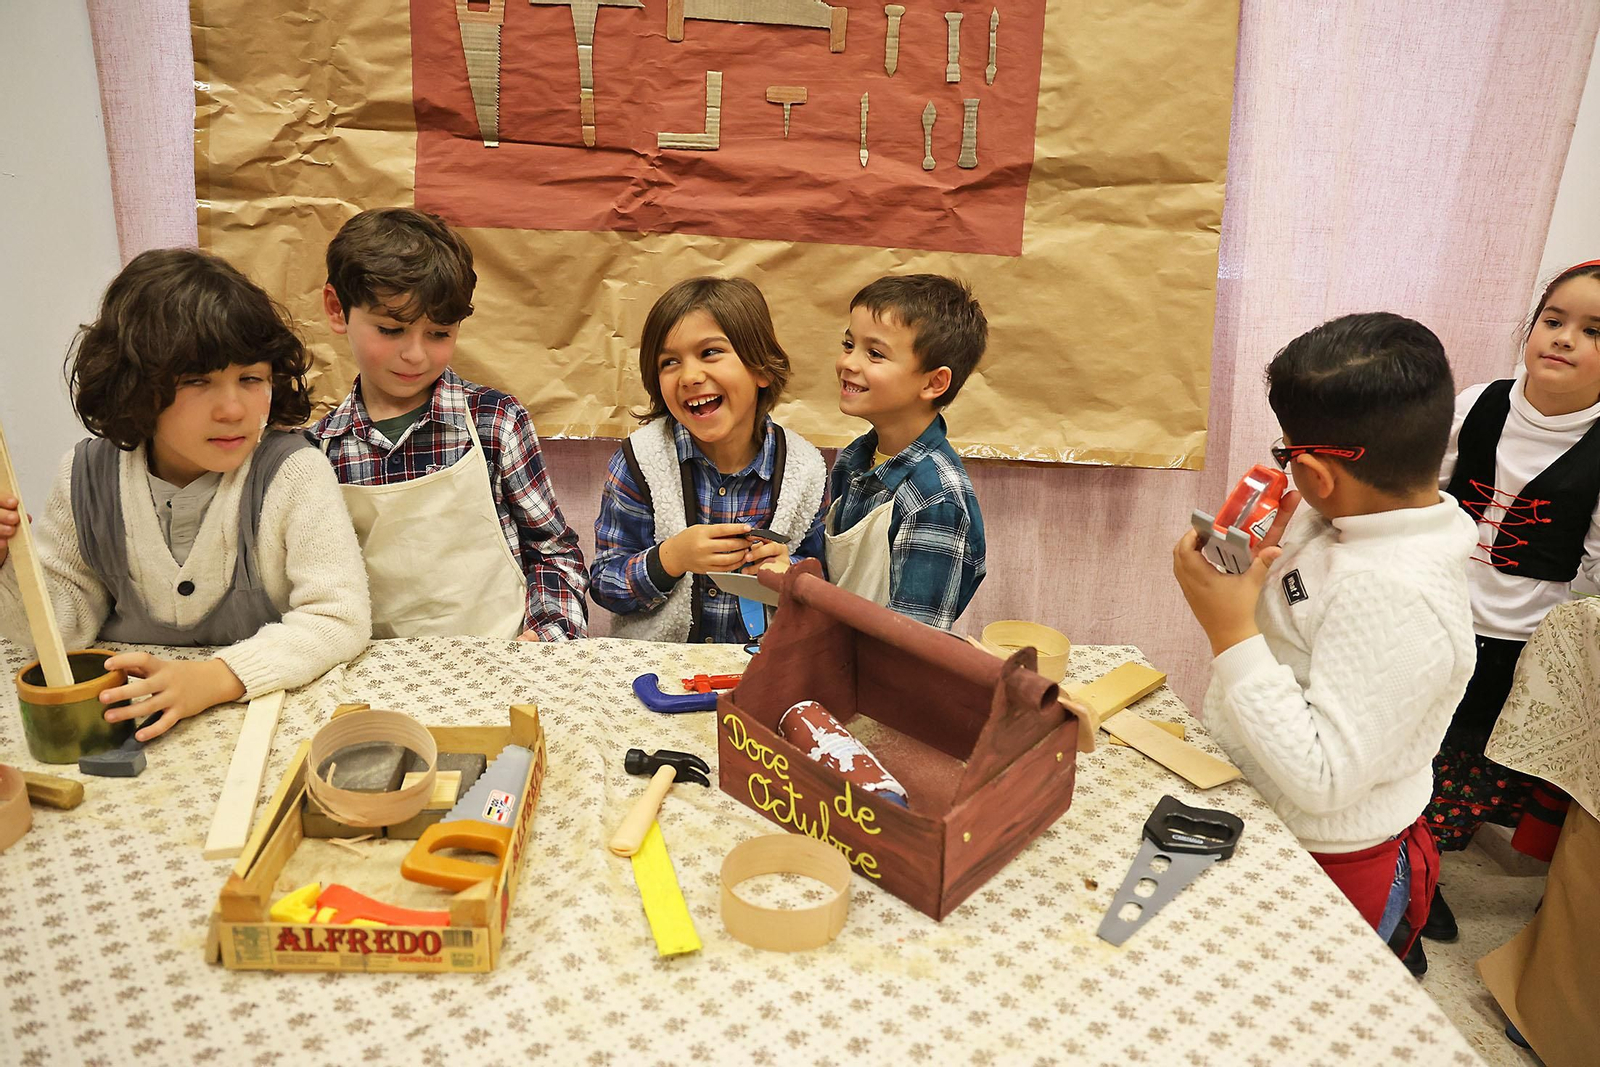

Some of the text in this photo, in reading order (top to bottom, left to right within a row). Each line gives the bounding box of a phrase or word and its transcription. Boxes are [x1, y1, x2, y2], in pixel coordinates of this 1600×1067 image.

[723, 714, 882, 834] Doce de
[275, 926, 443, 956] ALFREDO
